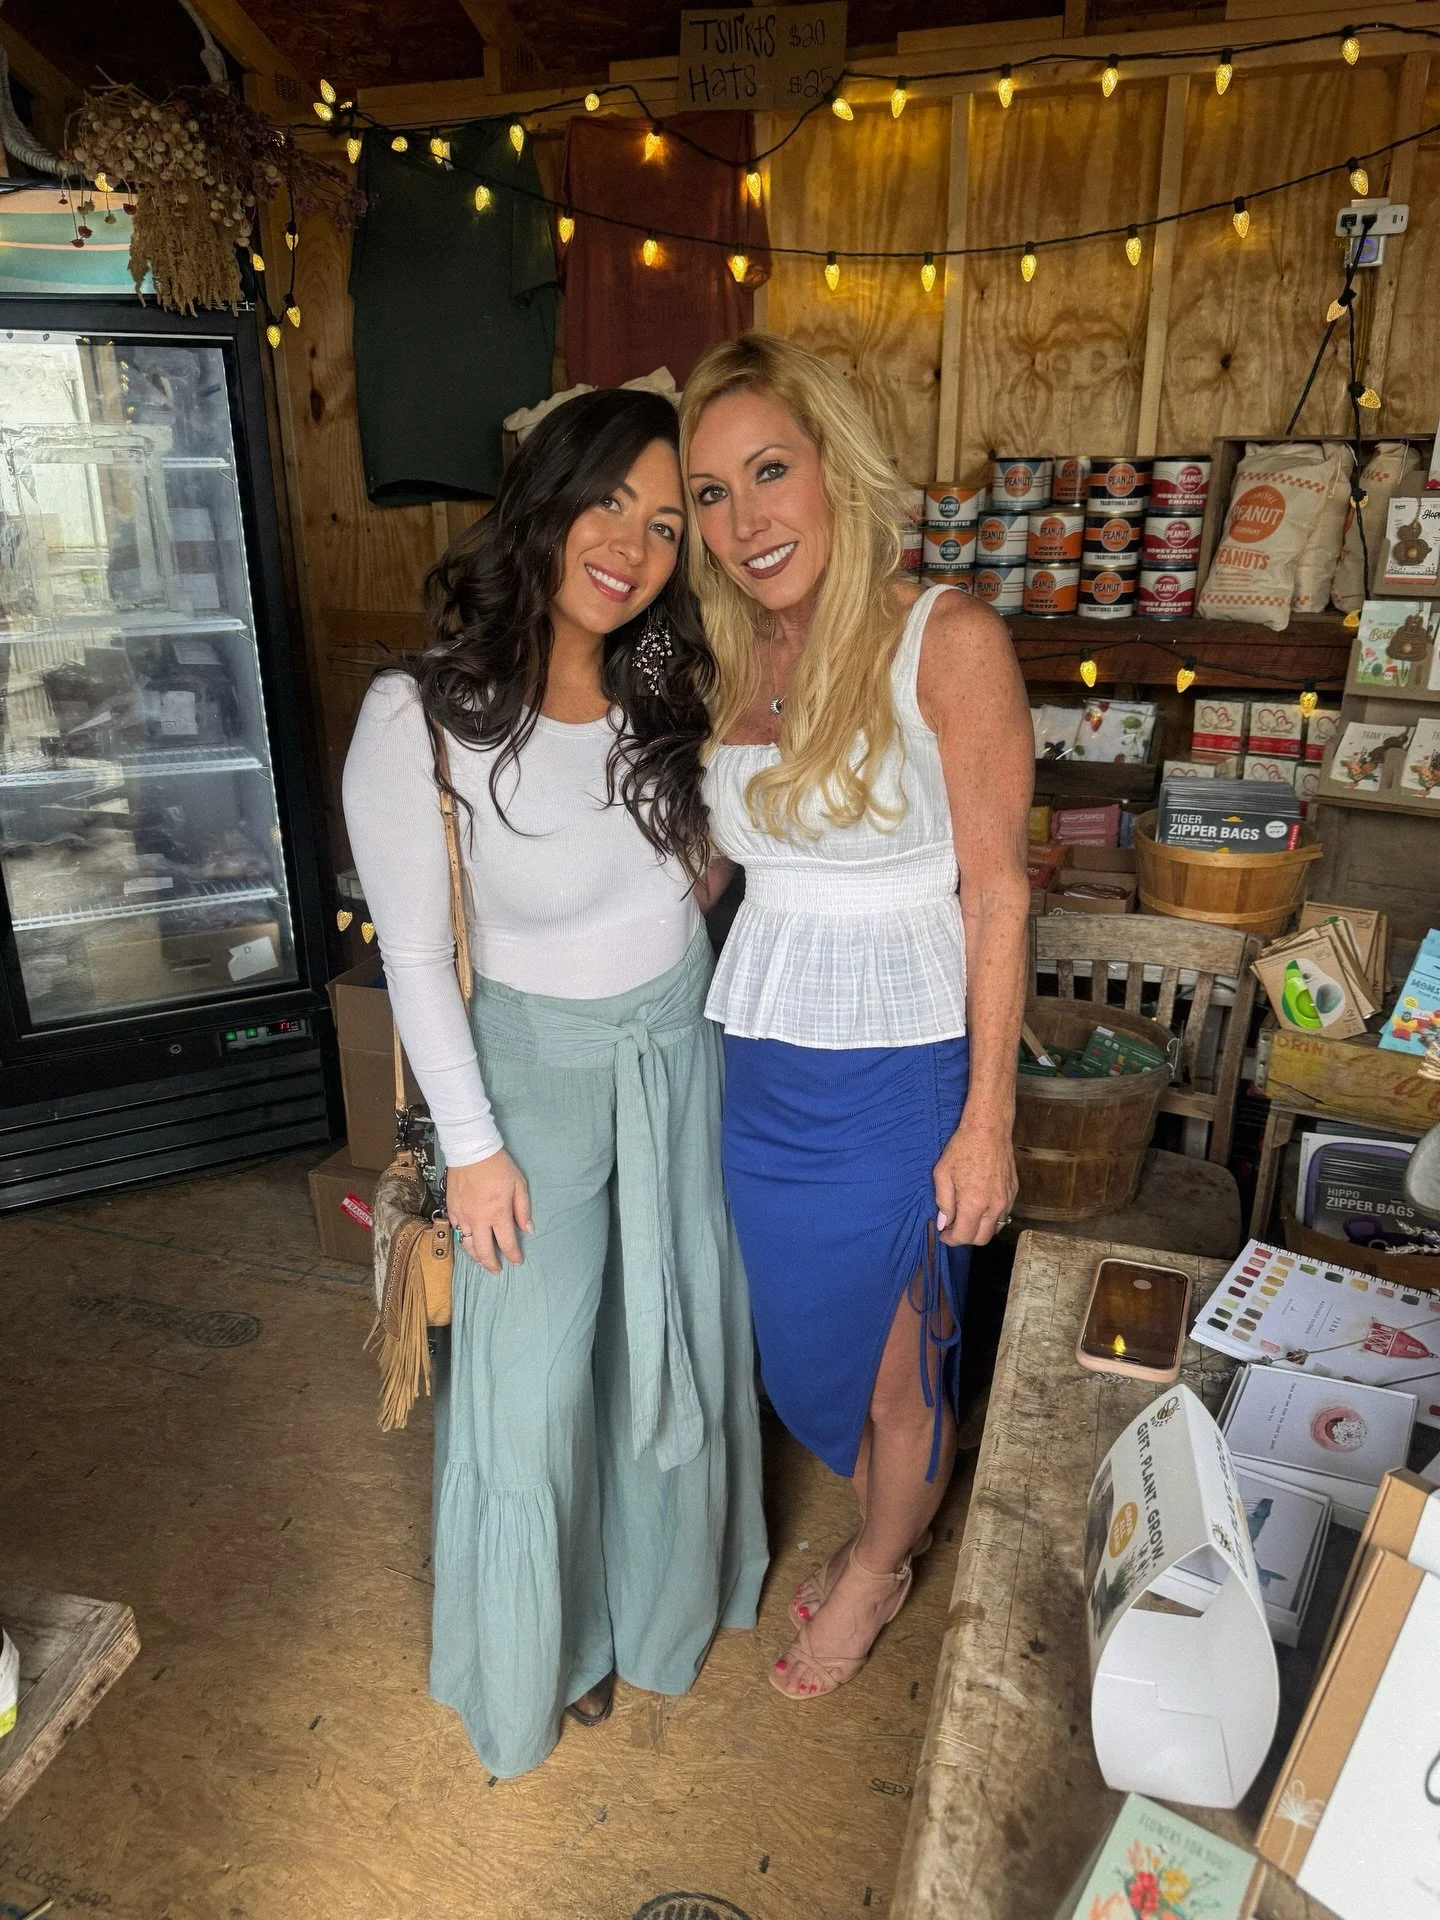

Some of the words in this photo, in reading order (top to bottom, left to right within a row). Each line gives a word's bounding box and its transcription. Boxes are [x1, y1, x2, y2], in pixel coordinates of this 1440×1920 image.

[789, 19, 826, 47] $20
[788, 67, 834, 98] $25
[1005, 477, 1031, 486] PEANUT
[1109, 476, 1134, 484] PEANUT
[939, 503, 960, 511] PEANUT
[1232, 504, 1284, 526] PEANUT
[981, 530, 1005, 539] PEANUT
[1040, 527, 1065, 536] PEANUT
[1102, 531, 1129, 540] PEANUT
[1167, 529, 1190, 538] PEANUT
[940, 547, 960, 555] PEANUT
[977, 583, 1000, 592] PEANUT
[1094, 583, 1121, 592] PEANUT
[1155, 583, 1179, 592] PEANUT
[1170, 813, 1202, 825] TIGER
[1168, 824, 1218, 838] ZIPPER
[1220, 827, 1260, 841] BAGS
[1327, 1187, 1361, 1199] HIPPO
[1325, 1196, 1373, 1213] ZIPPER
[1376, 1203, 1415, 1218] BAGS
[346, 1202, 373, 1224] FRAGILE
[1137, 1422, 1150, 1458] GIFT.
[1140, 1455, 1157, 1510] PLANT.
[1147, 1509, 1164, 1568] GROW.
